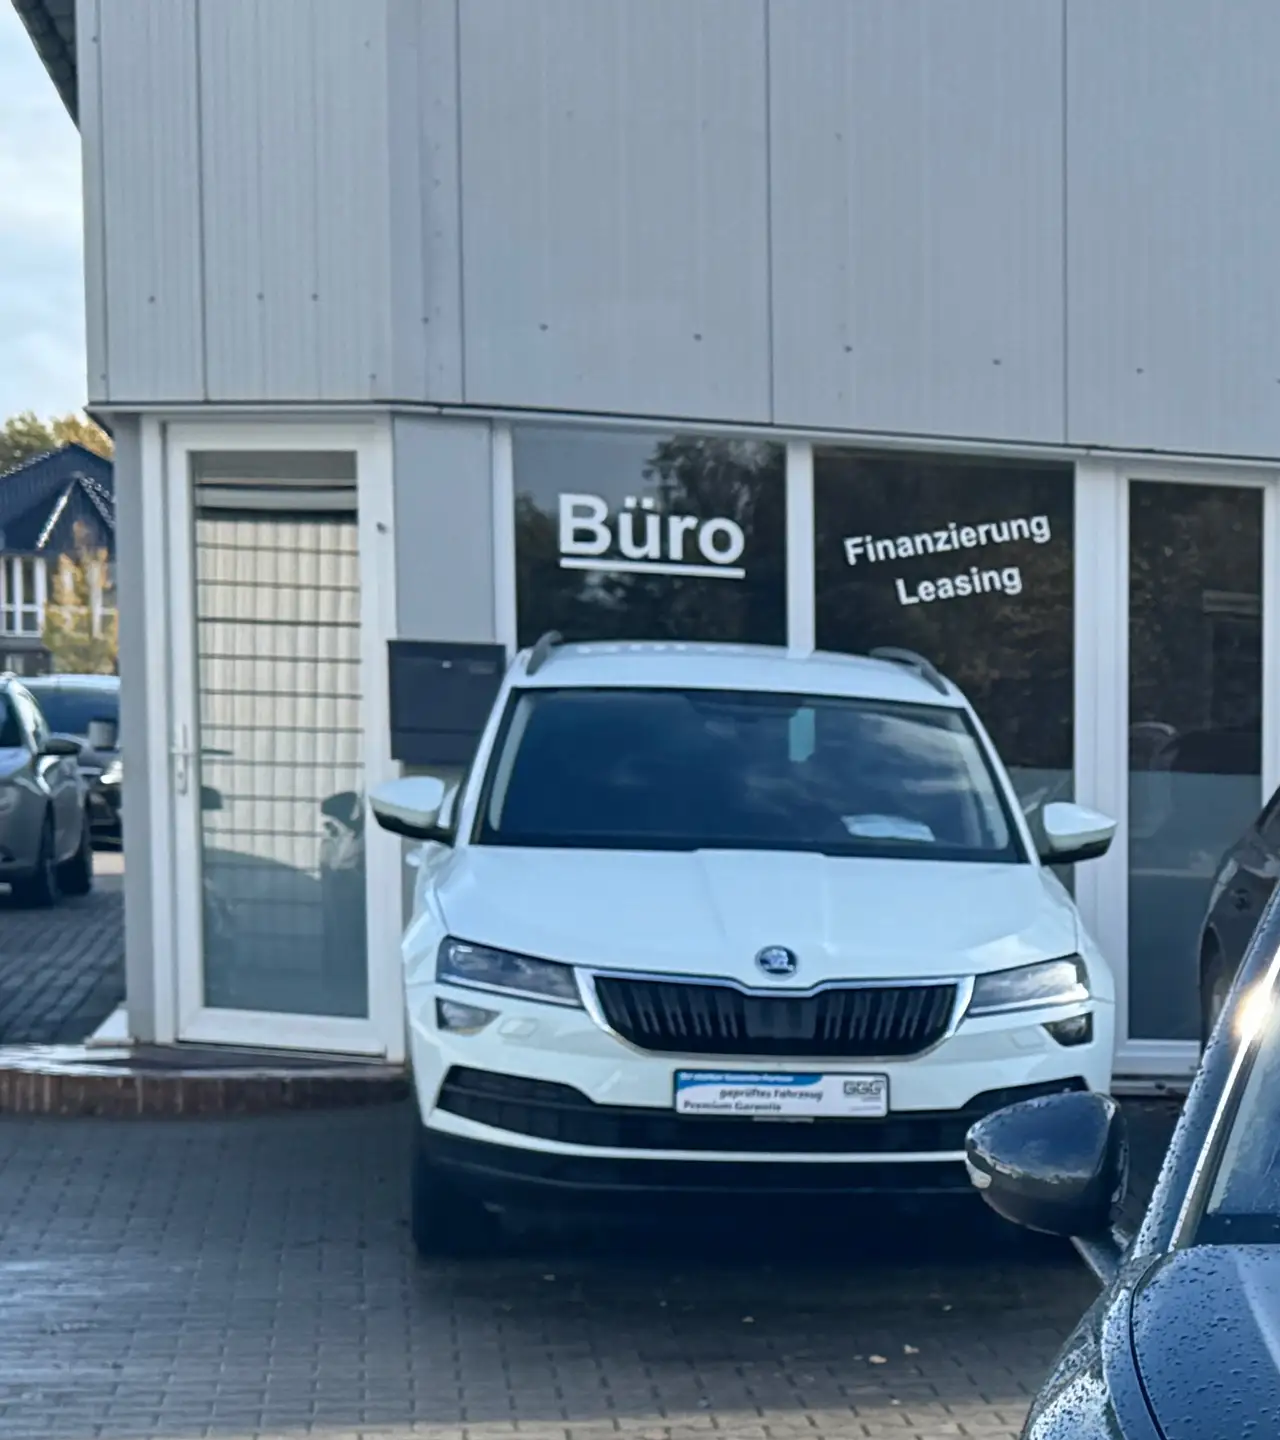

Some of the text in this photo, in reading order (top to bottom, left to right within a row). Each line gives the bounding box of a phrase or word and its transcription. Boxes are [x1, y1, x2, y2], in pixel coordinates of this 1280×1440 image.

[558, 493, 746, 566] Büro
[844, 513, 1052, 566] Finanzierung
[895, 566, 1023, 606] Leasing
[683, 1100, 733, 1111] Premium
[719, 1087, 824, 1103] geprüftes Fahrzeug
